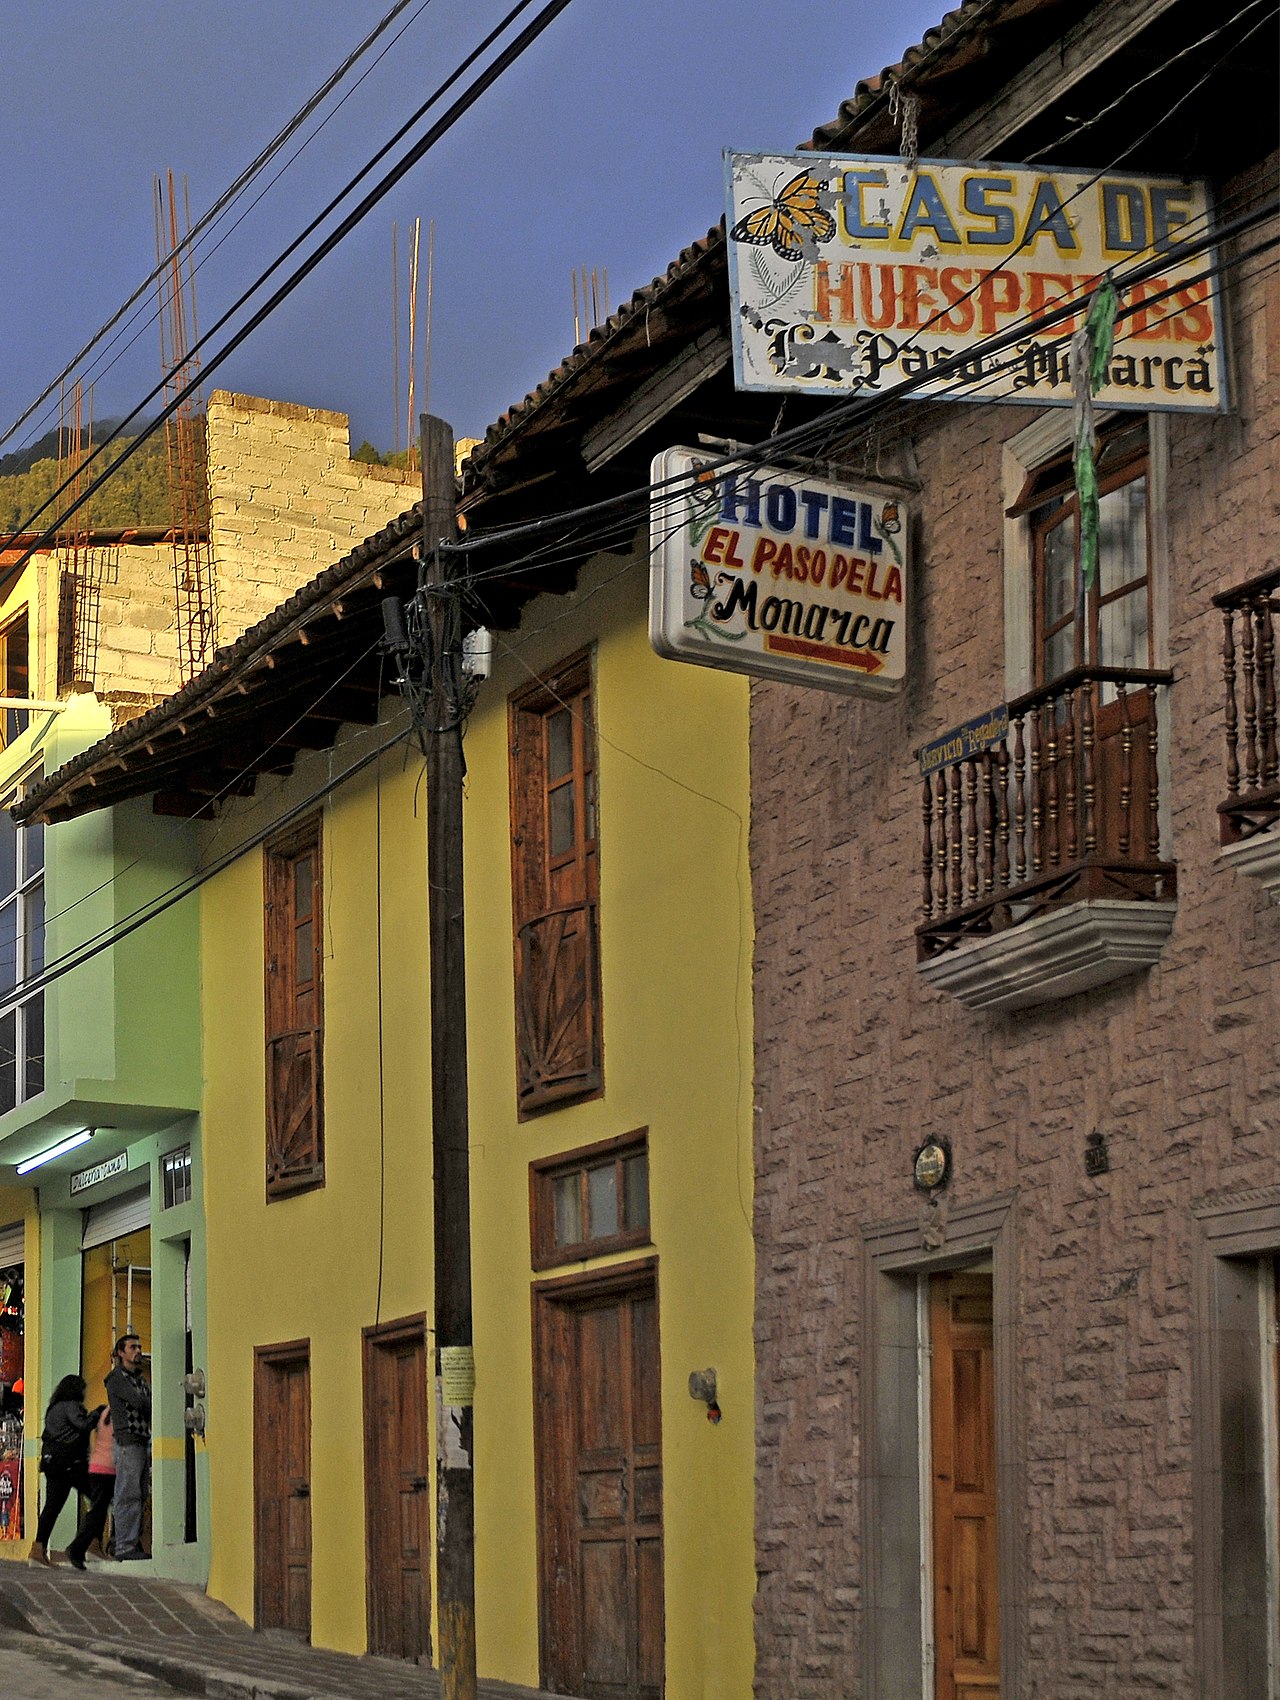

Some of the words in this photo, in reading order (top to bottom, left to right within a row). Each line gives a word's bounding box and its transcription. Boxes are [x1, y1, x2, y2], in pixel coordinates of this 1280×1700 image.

[839, 168, 1081, 256] CASA
[1100, 180, 1198, 258] DE
[816, 260, 1214, 342] HUESPEES
[721, 473, 883, 556] HOTEL
[703, 527, 744, 570] EL
[753, 536, 827, 590] PASO
[711, 571, 896, 655] Monarca
